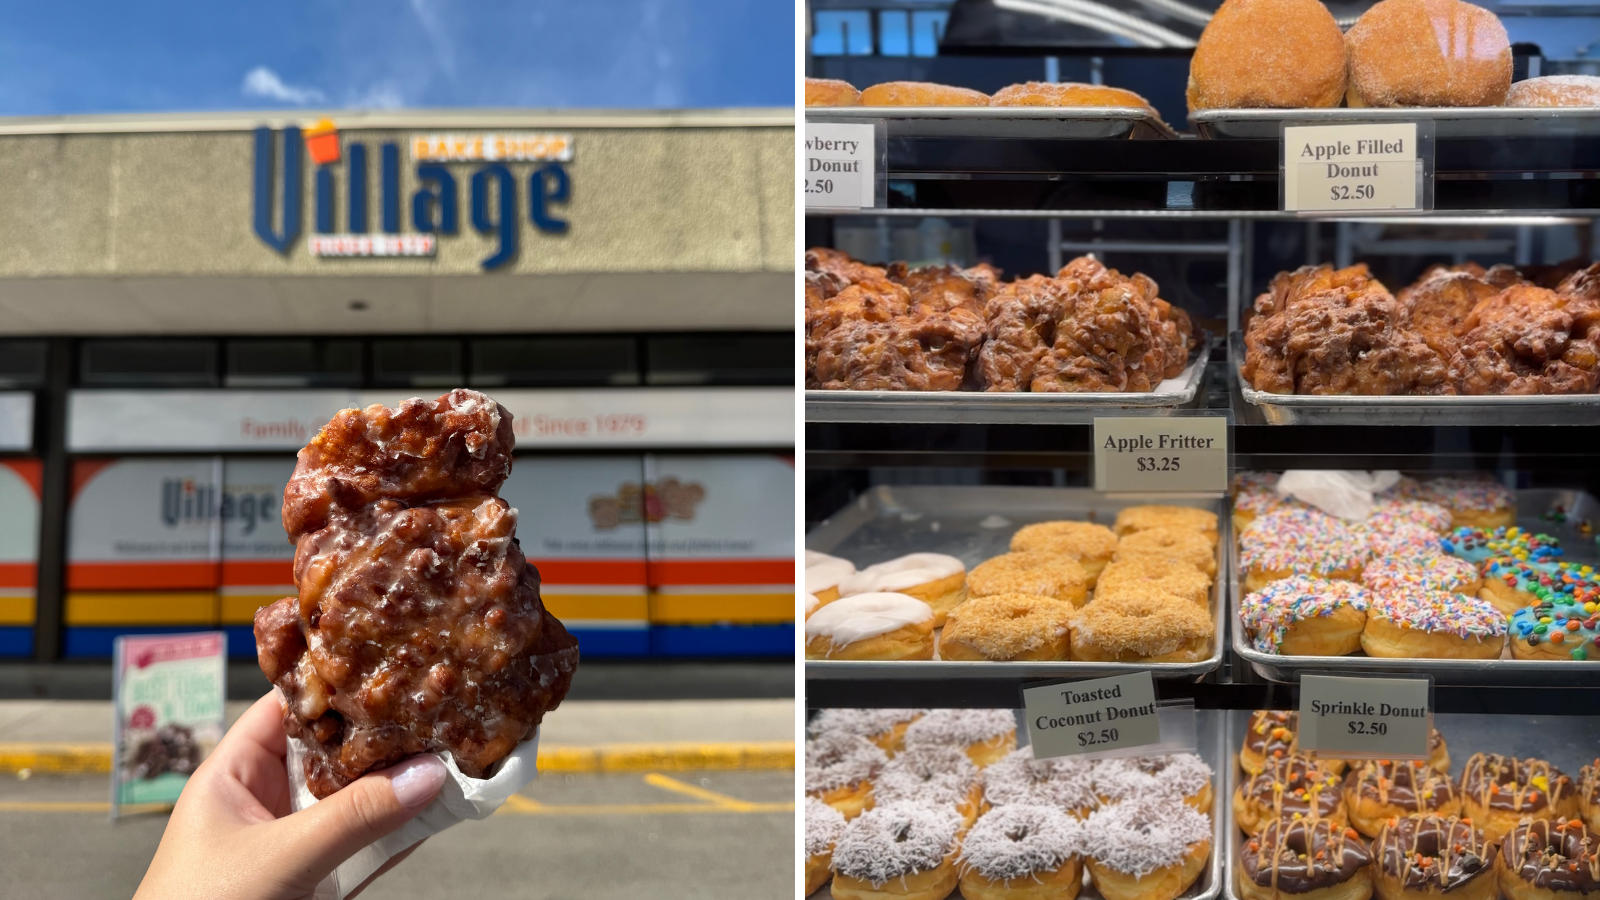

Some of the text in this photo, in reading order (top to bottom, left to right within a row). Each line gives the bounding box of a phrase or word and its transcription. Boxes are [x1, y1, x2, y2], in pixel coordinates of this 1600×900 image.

[413, 136, 569, 160] BAKE SHOP
[1300, 139, 1404, 160] Apple Filled
[808, 158, 860, 172] Donut
[1326, 163, 1379, 178] Donut
[253, 121, 571, 271] Village
[1330, 184, 1375, 201] $2.50
[241, 415, 308, 443] Family
[533, 413, 591, 437] Since
[595, 413, 649, 437] 1979
[1103, 434, 1214, 452] Apple Fritter
[1137, 457, 1180, 472] $3.25
[161, 478, 277, 537] Village
[1061, 684, 1122, 705] Toasted
[1035, 702, 1156, 730] Coconut Donut
[1311, 700, 1426, 718] Sprinkle Donut
[1077, 728, 1119, 747] $2.50
[1347, 721, 1388, 735] $2.50
